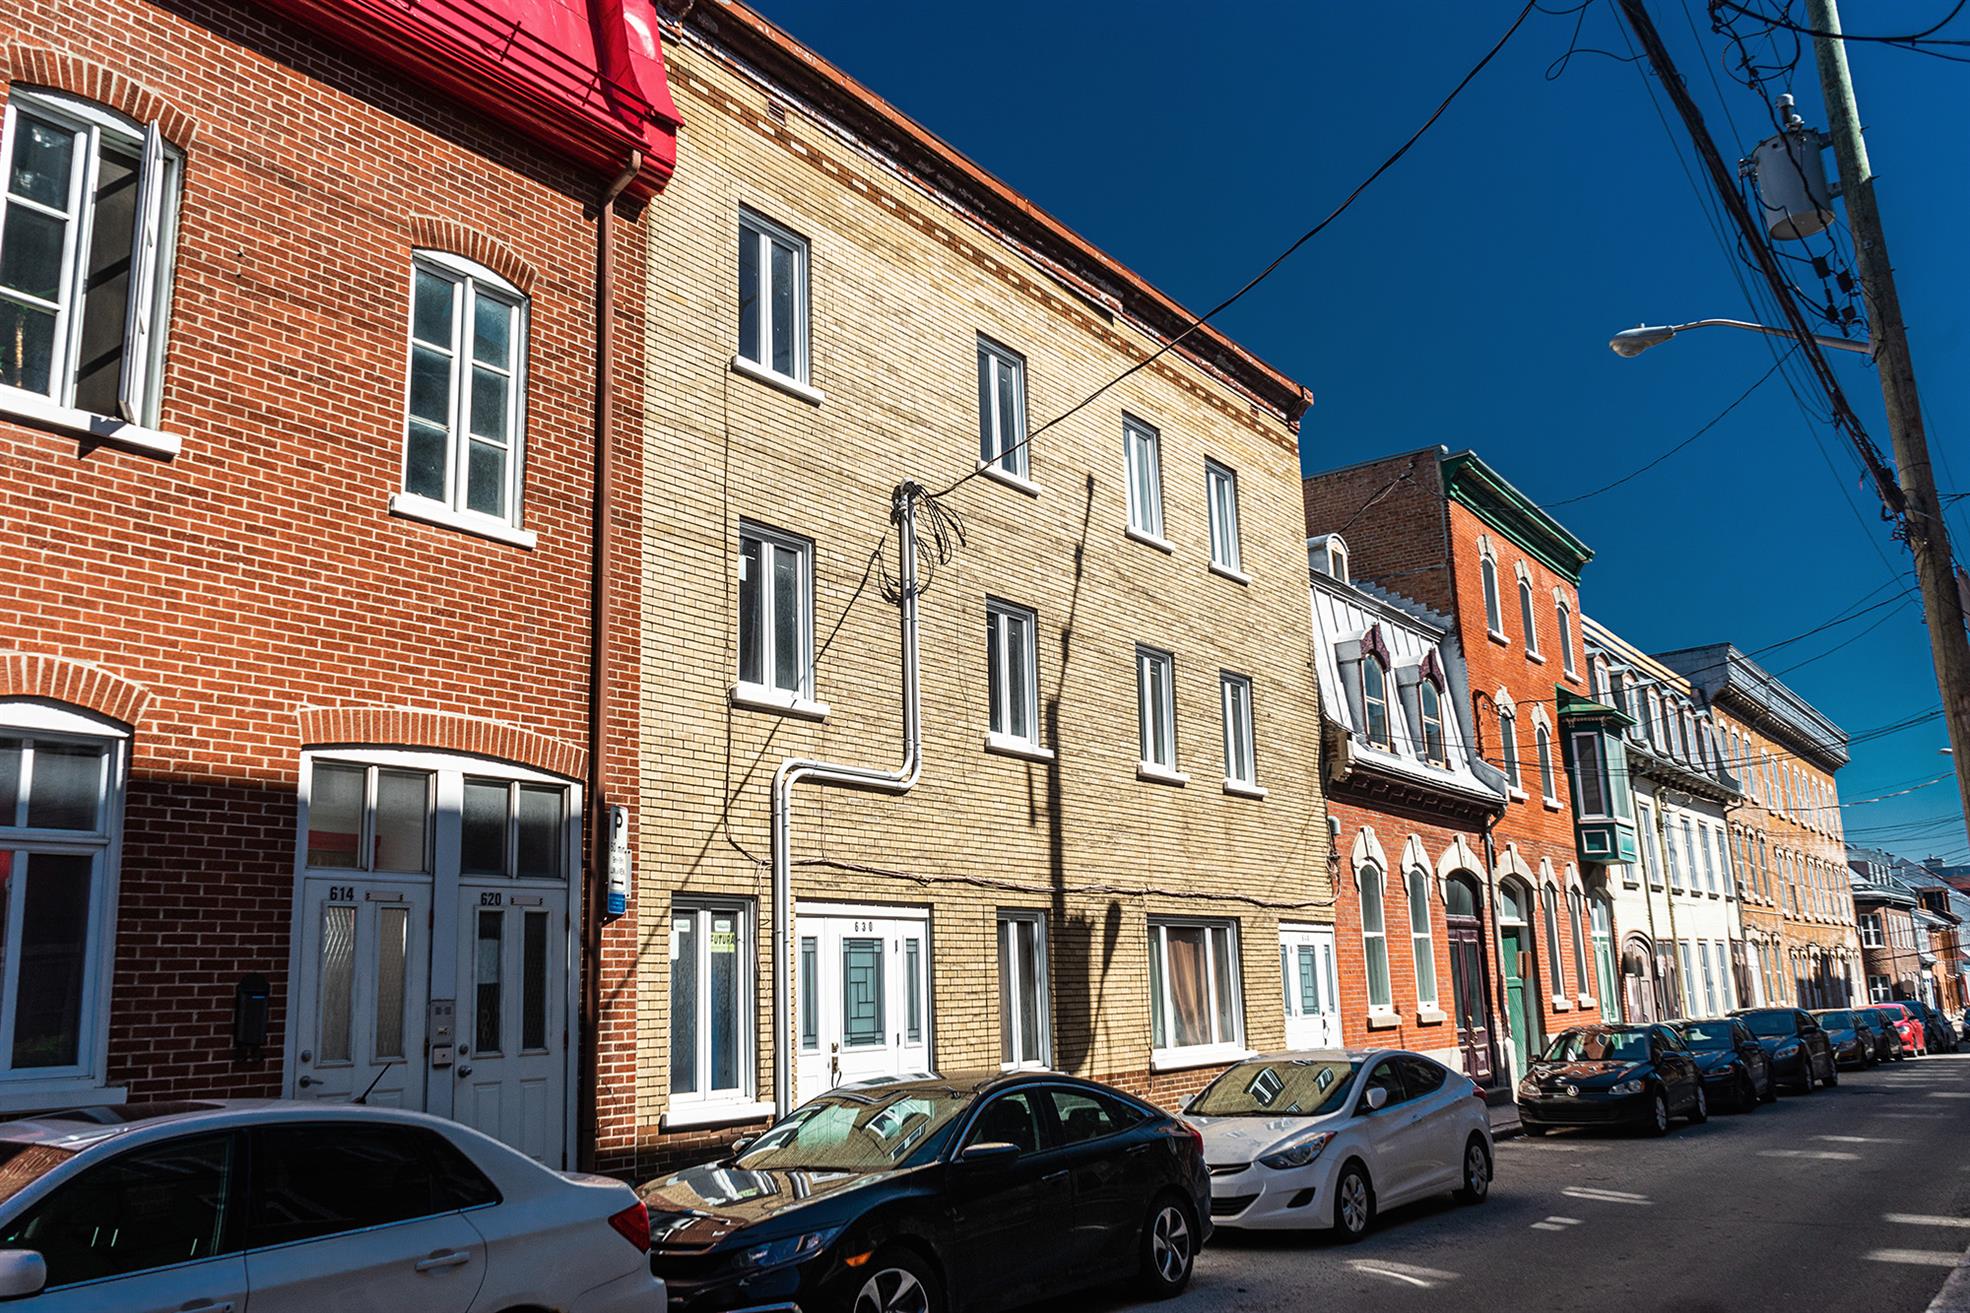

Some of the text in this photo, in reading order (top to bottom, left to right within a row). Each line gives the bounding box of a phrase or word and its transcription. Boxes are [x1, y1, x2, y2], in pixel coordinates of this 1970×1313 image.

[615, 812, 623, 839] P
[330, 887, 354, 901] 614
[481, 892, 502, 906] 620
[855, 921, 873, 932] 630
